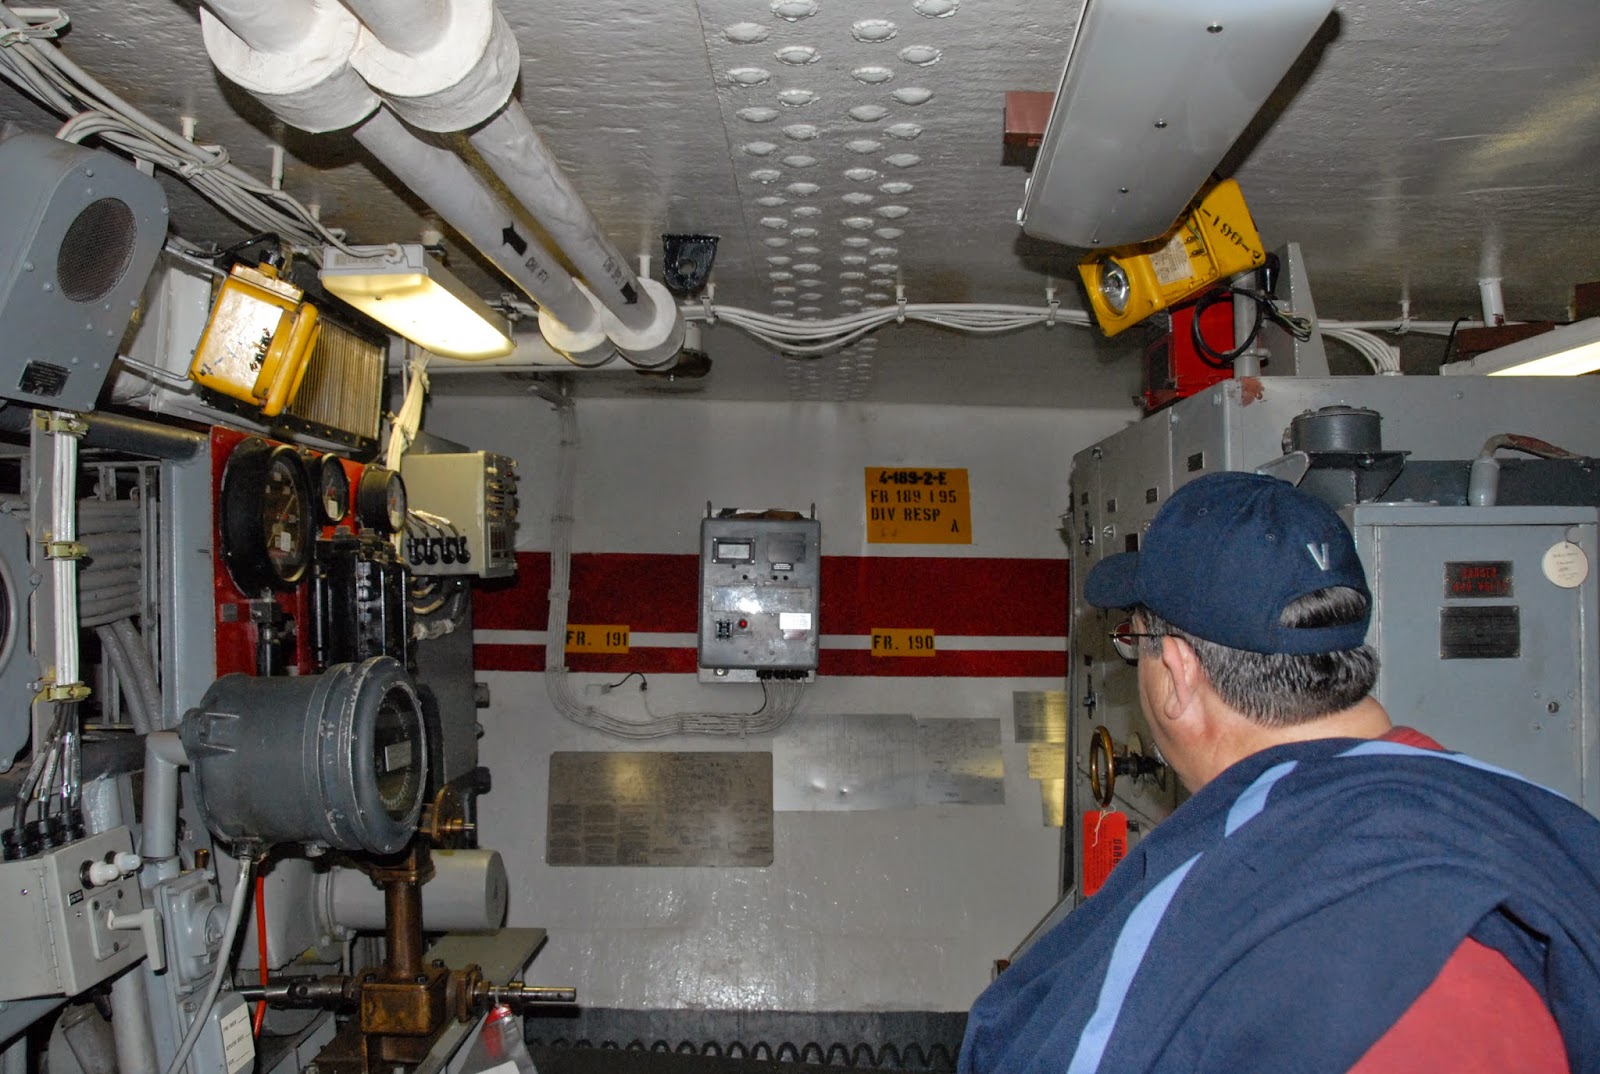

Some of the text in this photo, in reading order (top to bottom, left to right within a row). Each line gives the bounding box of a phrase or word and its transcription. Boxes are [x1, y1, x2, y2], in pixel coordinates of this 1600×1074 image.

[871, 490, 888, 503] FR
[897, 490, 921, 503] 189
[871, 507, 940, 521] DIV RESP
[1306, 543, 1329, 570] V
[1461, 567, 1497, 578] DANGER
[566, 631, 627, 646] FR. 191
[873, 634, 933, 650] FR. 190
